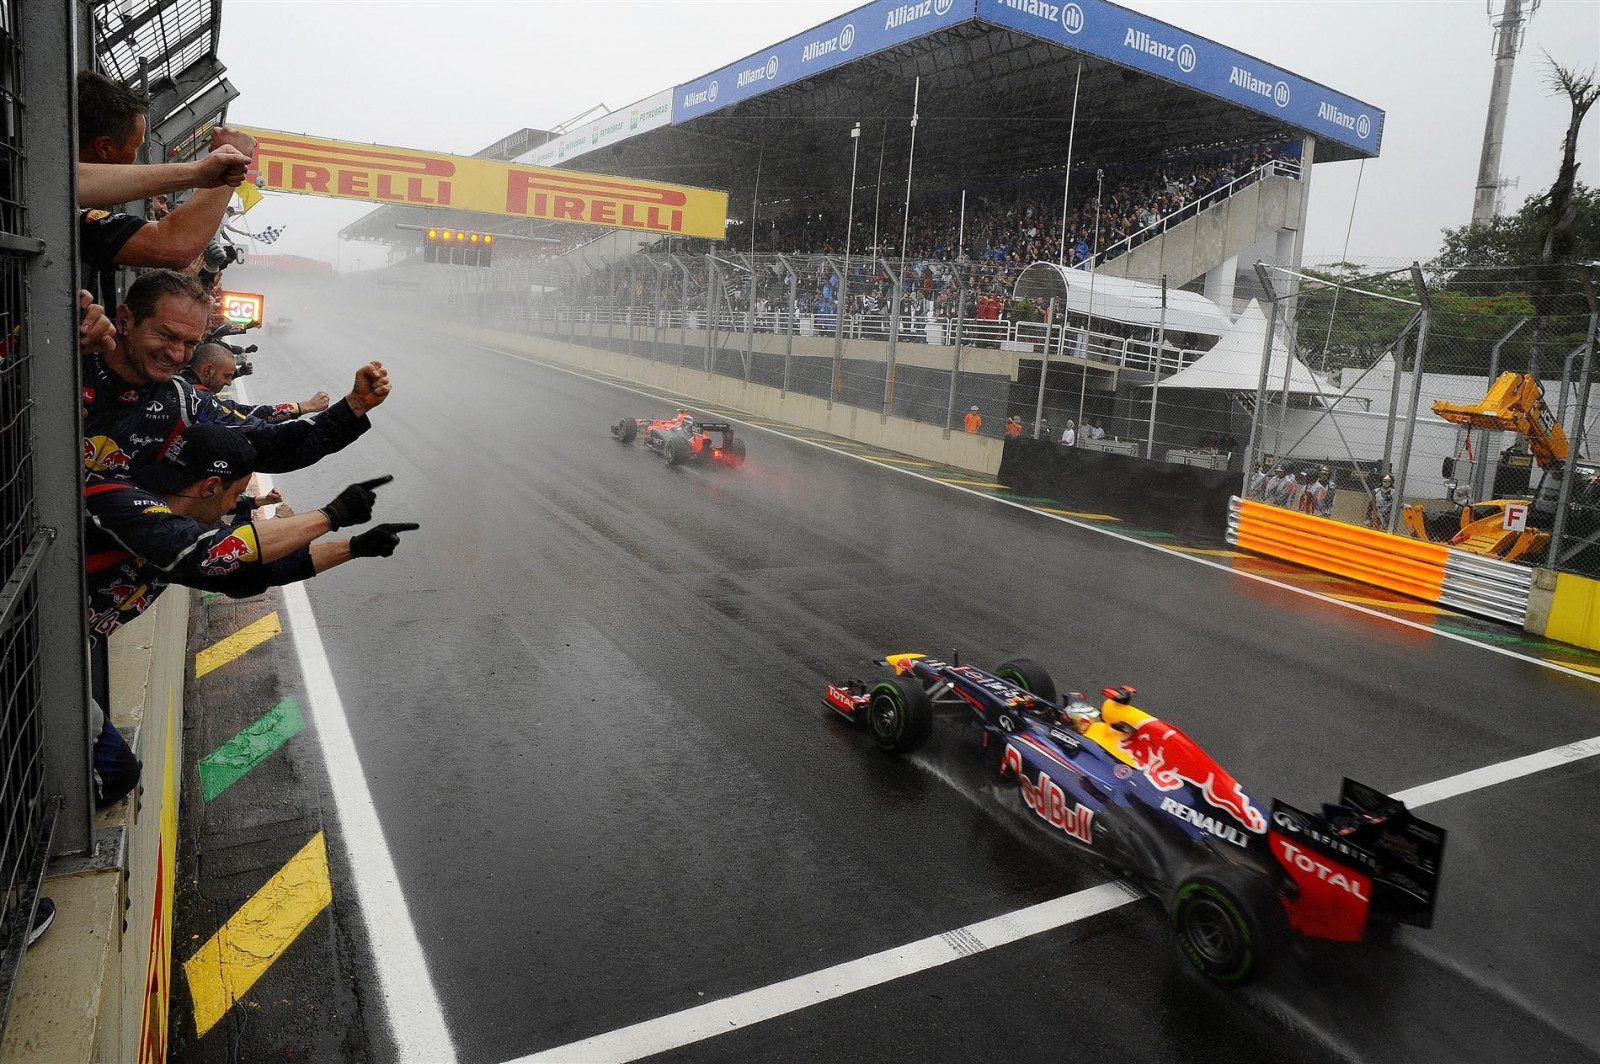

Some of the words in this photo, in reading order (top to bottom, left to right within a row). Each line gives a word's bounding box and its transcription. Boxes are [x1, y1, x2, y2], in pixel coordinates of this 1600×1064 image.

[884, 0, 931, 30] Allianz
[801, 36, 838, 63] Allianz
[1124, 28, 1176, 62] Allianz
[736, 66, 765, 88] Allianz
[1229, 66, 1273, 98] Allianz
[639, 103, 668, 123] PETROBRAS
[683, 87, 708, 109] Allianz
[1317, 101, 1355, 130] Allianz
[248, 136, 456, 206] PIRELLI
[506, 169, 687, 232] PIRELLI
[1507, 508, 1523, 527] F
[827, 685, 855, 711] TOTAL
[1046, 778, 1094, 845] Bull
[1160, 796, 1248, 848] RENAULT
[1280, 840, 1369, 903] TOTAL
